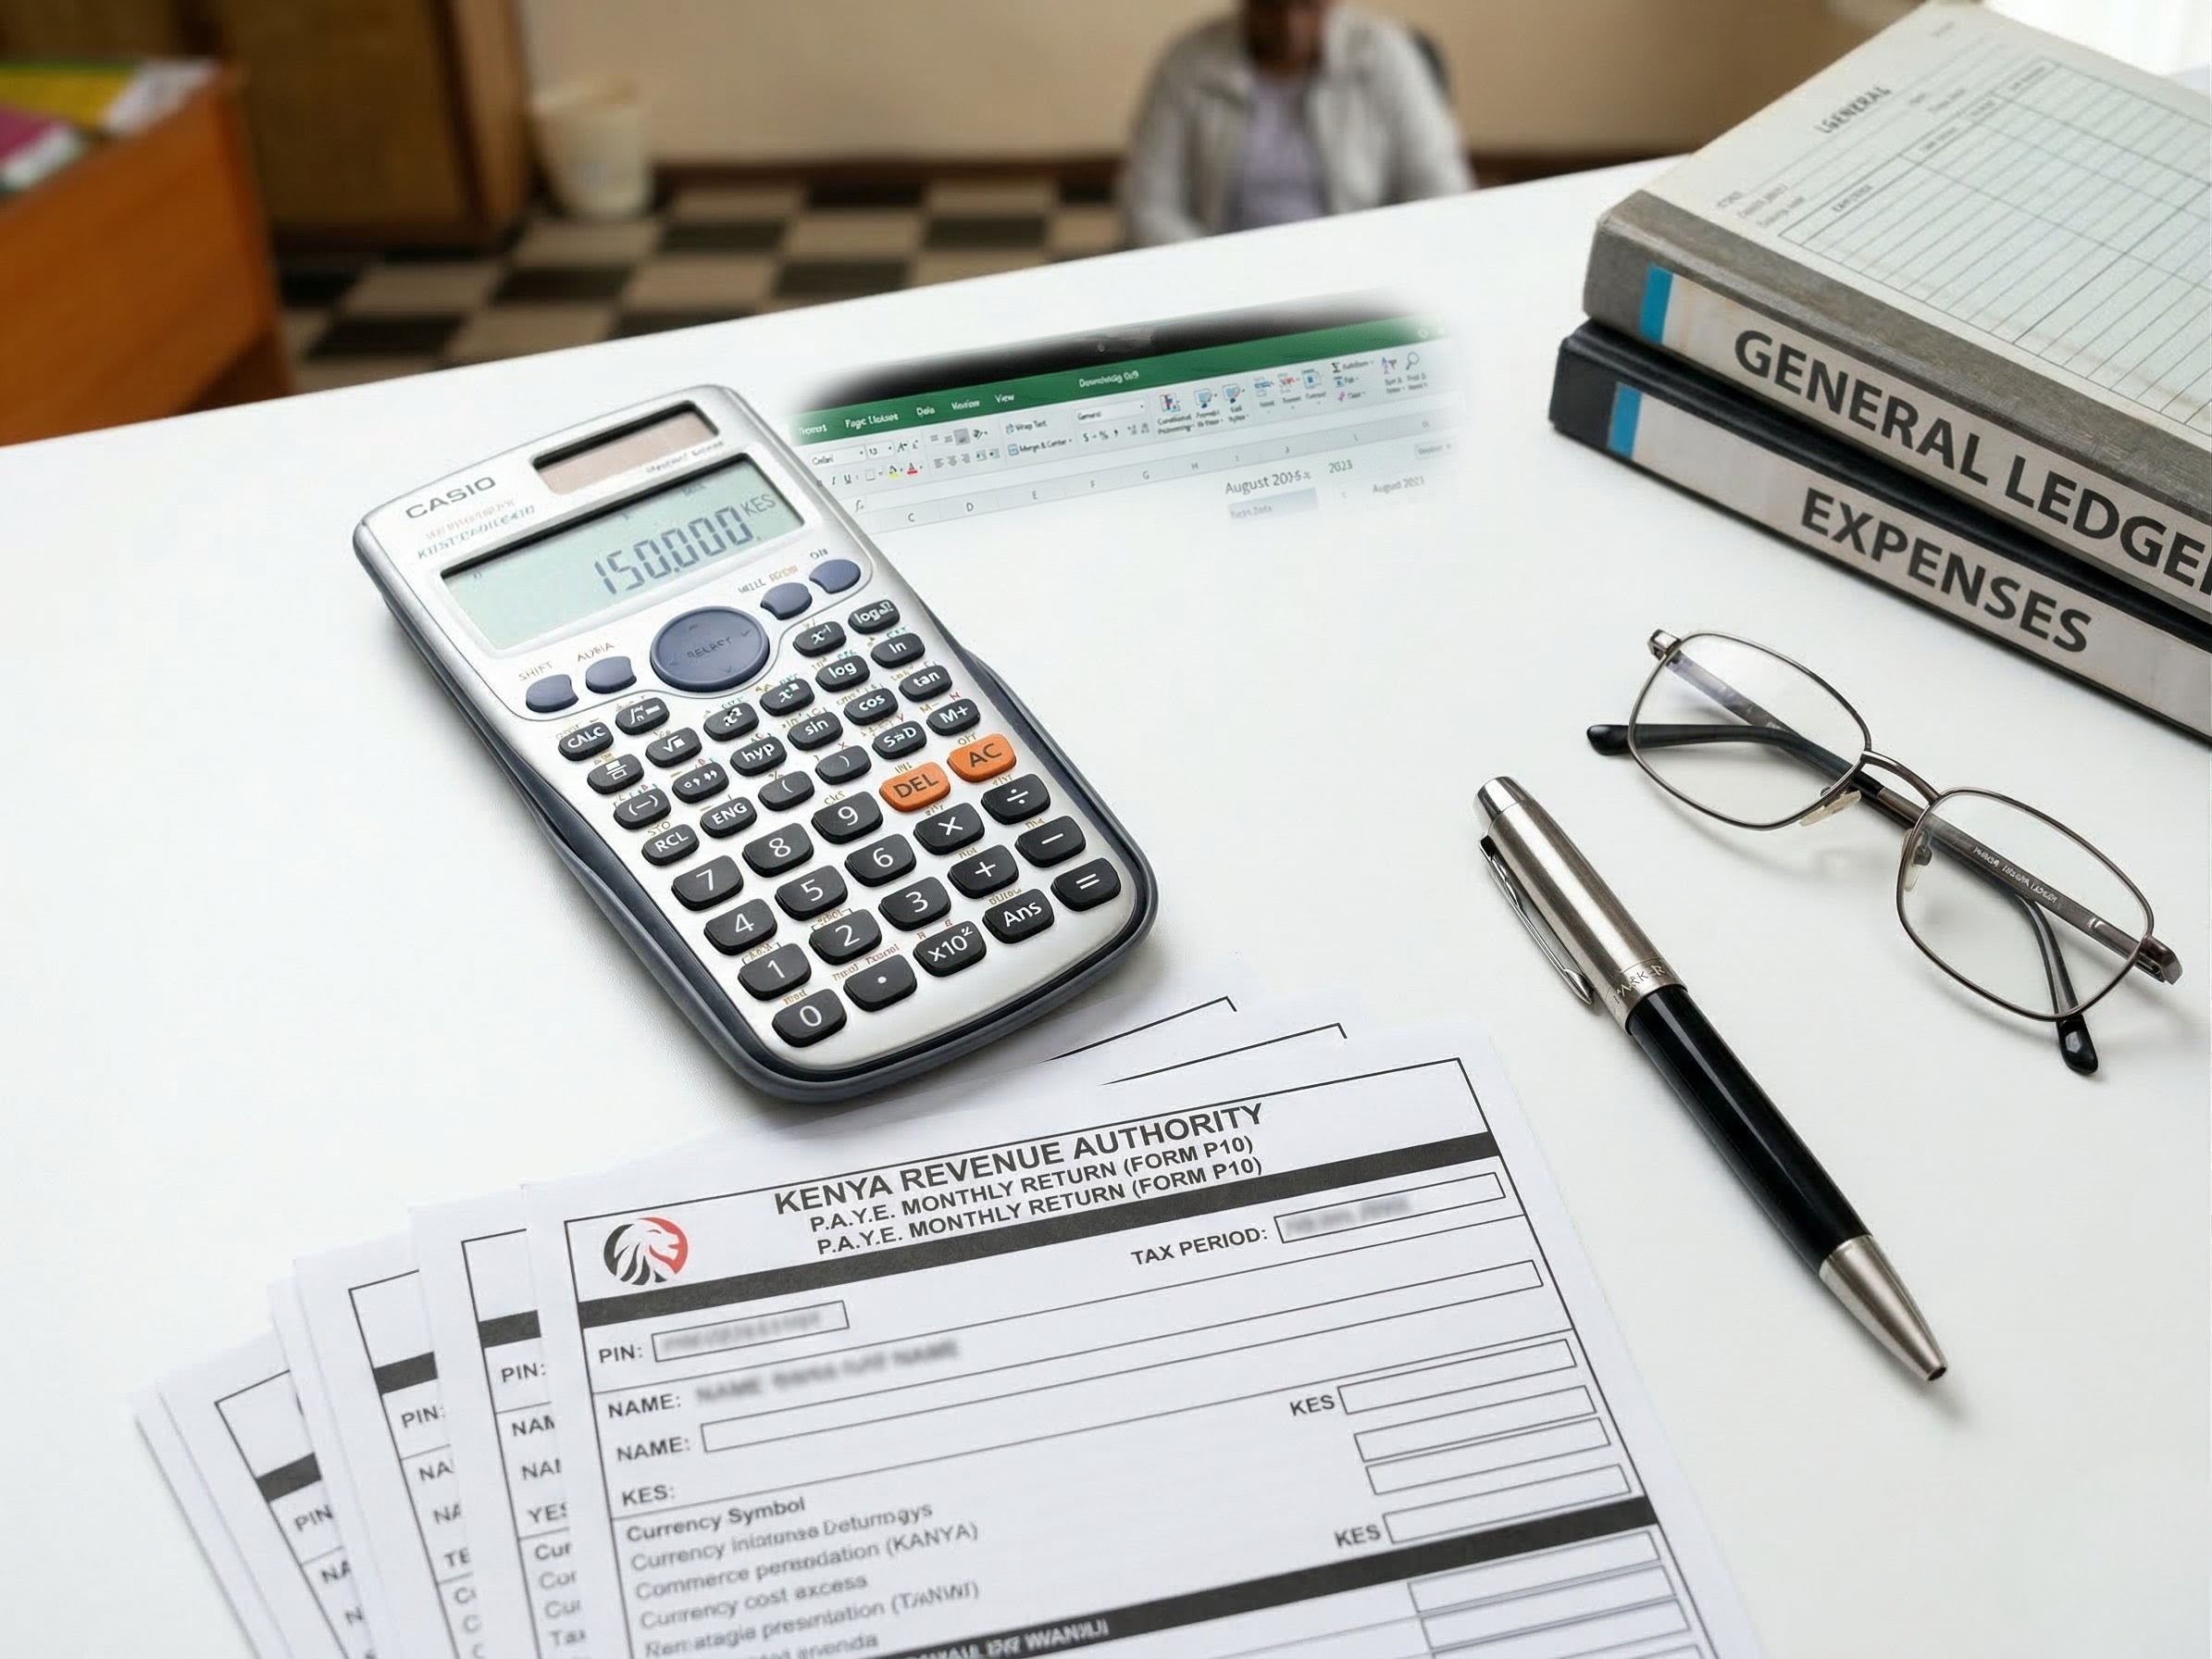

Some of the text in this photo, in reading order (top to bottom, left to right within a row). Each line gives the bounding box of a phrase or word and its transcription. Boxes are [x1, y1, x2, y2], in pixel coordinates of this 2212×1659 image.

[1734, 331, 1988, 487] GENERAL
[1225, 476, 1270, 495] August
[404, 476, 497, 520] CASIO
[743, 493, 777, 519] KES
[1801, 488, 2093, 653] EXPENSES
[517, 660, 553, 683] SHIFT
[828, 663, 856, 680] log
[913, 672, 940, 689] tan
[859, 694, 886, 711] cos
[938, 705, 968, 725] M+
[567, 726, 606, 749] CALC
[741, 743, 776, 763] hyp
[969, 743, 1002, 767] AC
[892, 773, 939, 799] DEL
[711, 803, 748, 826] ENG
[838, 805, 859, 827] 9
[654, 831, 689, 853] RCL
[768, 838, 791, 858] 8
[872, 847, 893, 868] 6
[696, 868, 714, 891] 7
[800, 879, 824, 903] 5
[905, 891, 927, 913] 3
[733, 912, 755, 934] 4
[1003, 902, 1042, 929] Ans
[834, 924, 860, 948] 2
[766, 959, 785, 980] 1
[799, 1004, 823, 1028] 0
[775, 1103, 1262, 1215] KENYA REVENUE AUTHORITY
[809, 1134, 1254, 1233] P.A.Y.E. MONTHLY RETURN (FORM P10)
[816, 1156, 1261, 1256] P.A.Y.E. MONTHLY RETURN (FORM P10)
[1131, 1227, 1268, 1266] TAX PERIOD:
[599, 1343, 643, 1364] PIN:
[501, 1363, 546, 1382] PIN:
[608, 1394, 681, 1418] NAME:
[1290, 1395, 1335, 1416] KES
[616, 1437, 690, 1461] NAME:
[622, 1484, 675, 1507] KES:
[627, 1497, 805, 1542] Currency Symbol
[1335, 1526, 1381, 1547] KES
[631, 1541, 725, 1571] Currency
[636, 1568, 749, 1600] Commerce
[887, 1522, 977, 1555] (KANYA)
